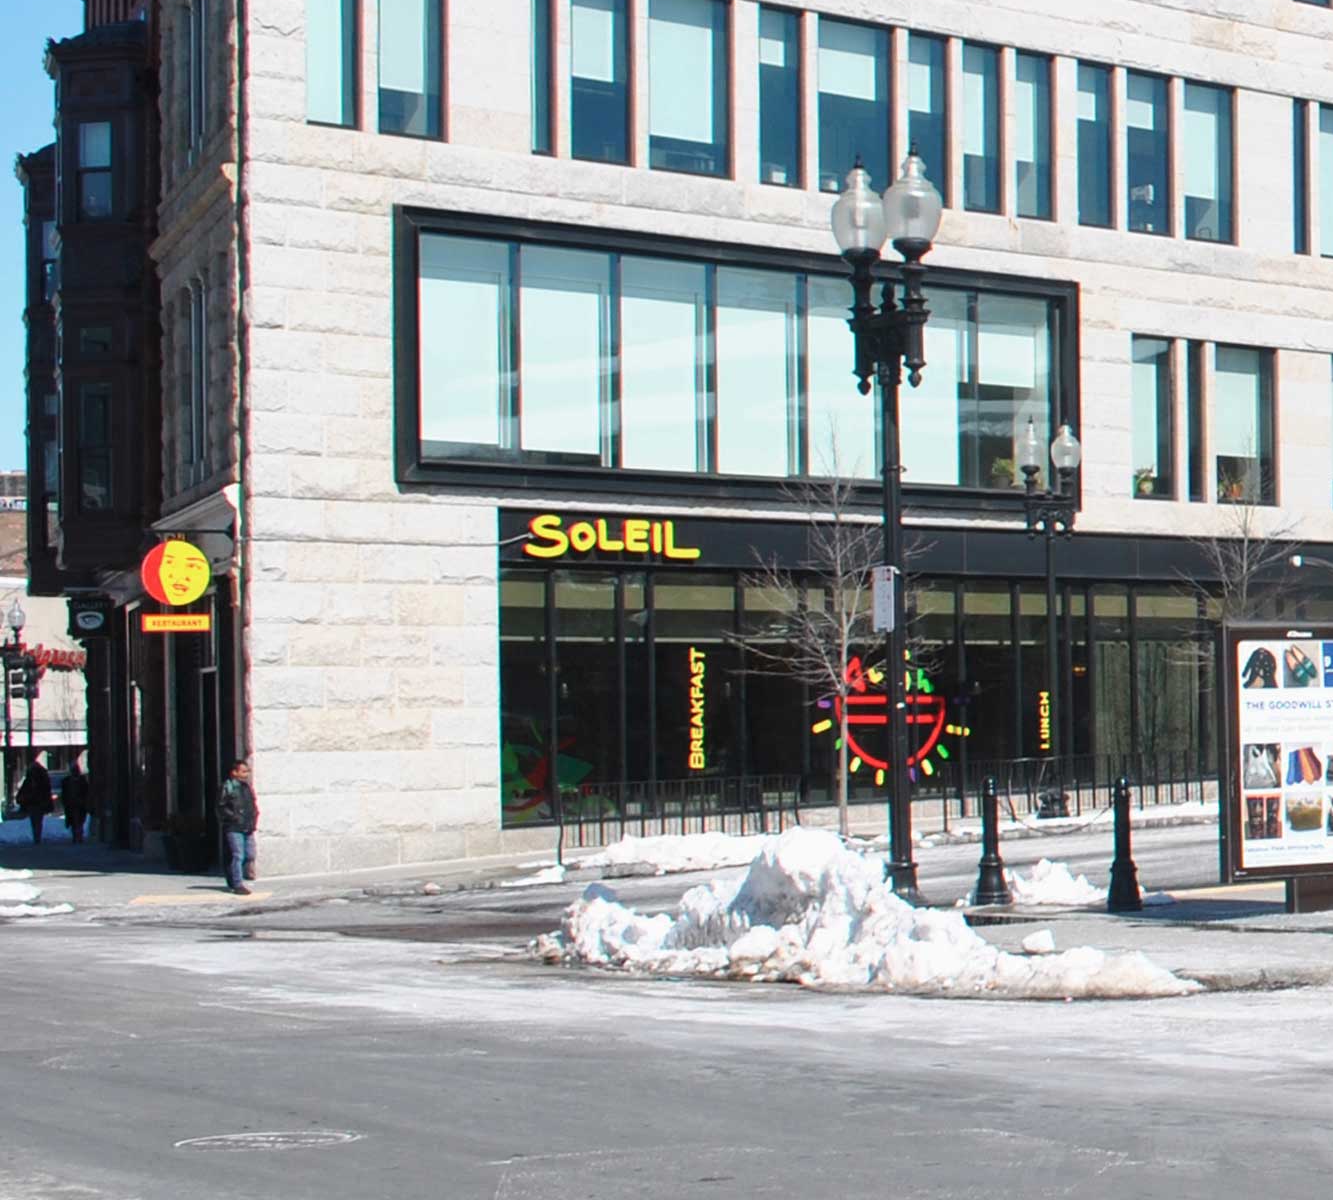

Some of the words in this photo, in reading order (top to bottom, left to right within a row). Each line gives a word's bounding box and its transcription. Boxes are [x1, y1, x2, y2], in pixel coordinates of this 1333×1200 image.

[523, 514, 701, 558] SOLEIL
[689, 647, 706, 770] BREAKFAST
[1039, 691, 1050, 750] LUNCH
[1246, 701, 1264, 710] THE
[1268, 699, 1322, 710] GOODWILL
